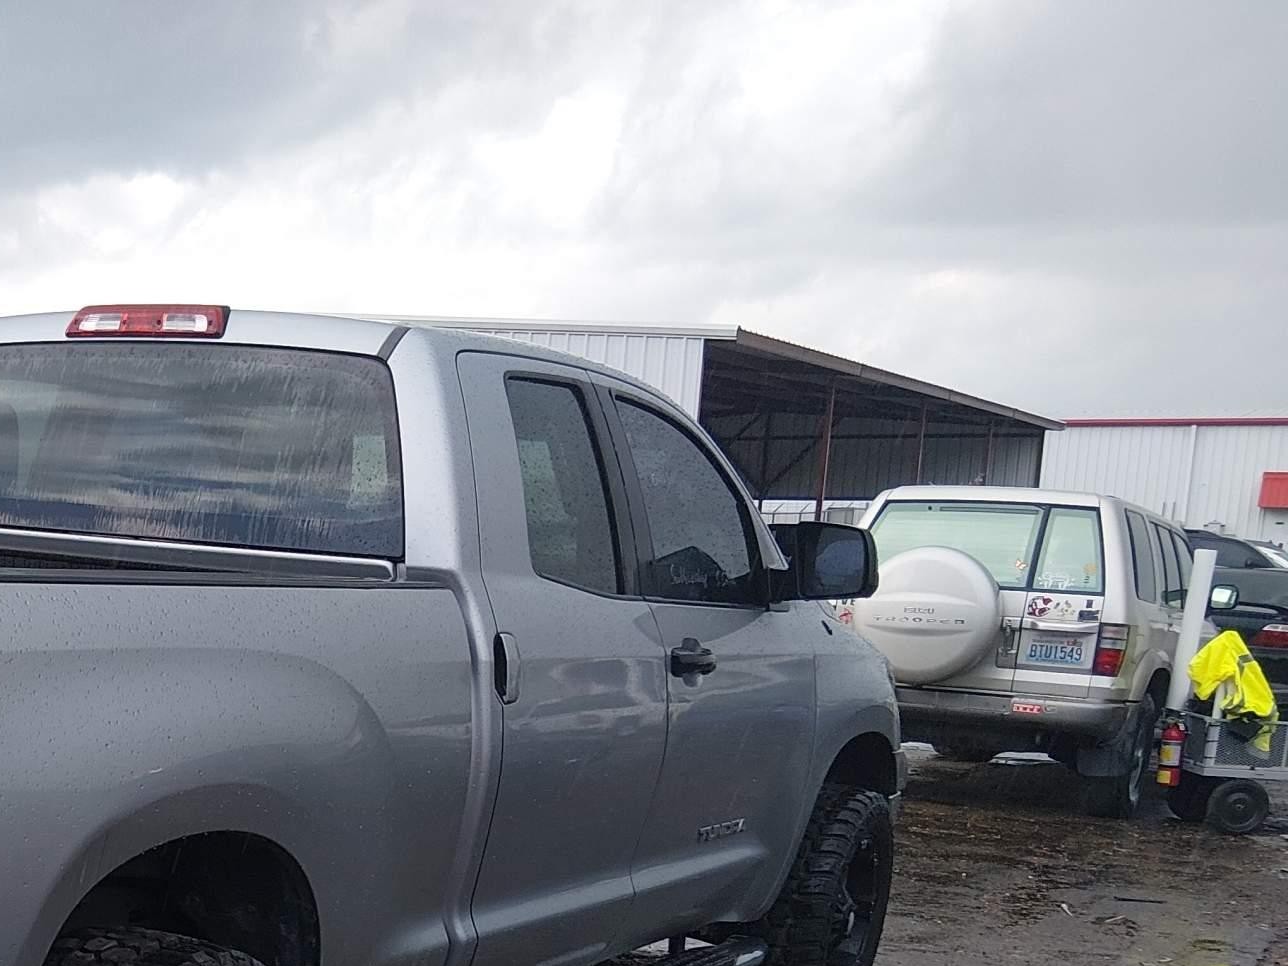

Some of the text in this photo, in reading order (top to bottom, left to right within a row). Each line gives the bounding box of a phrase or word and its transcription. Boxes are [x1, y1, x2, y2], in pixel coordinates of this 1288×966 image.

[903, 606, 935, 615] ISUZU
[872, 614, 966, 625] TROOPER
[1029, 643, 1083, 662] BTU1549
